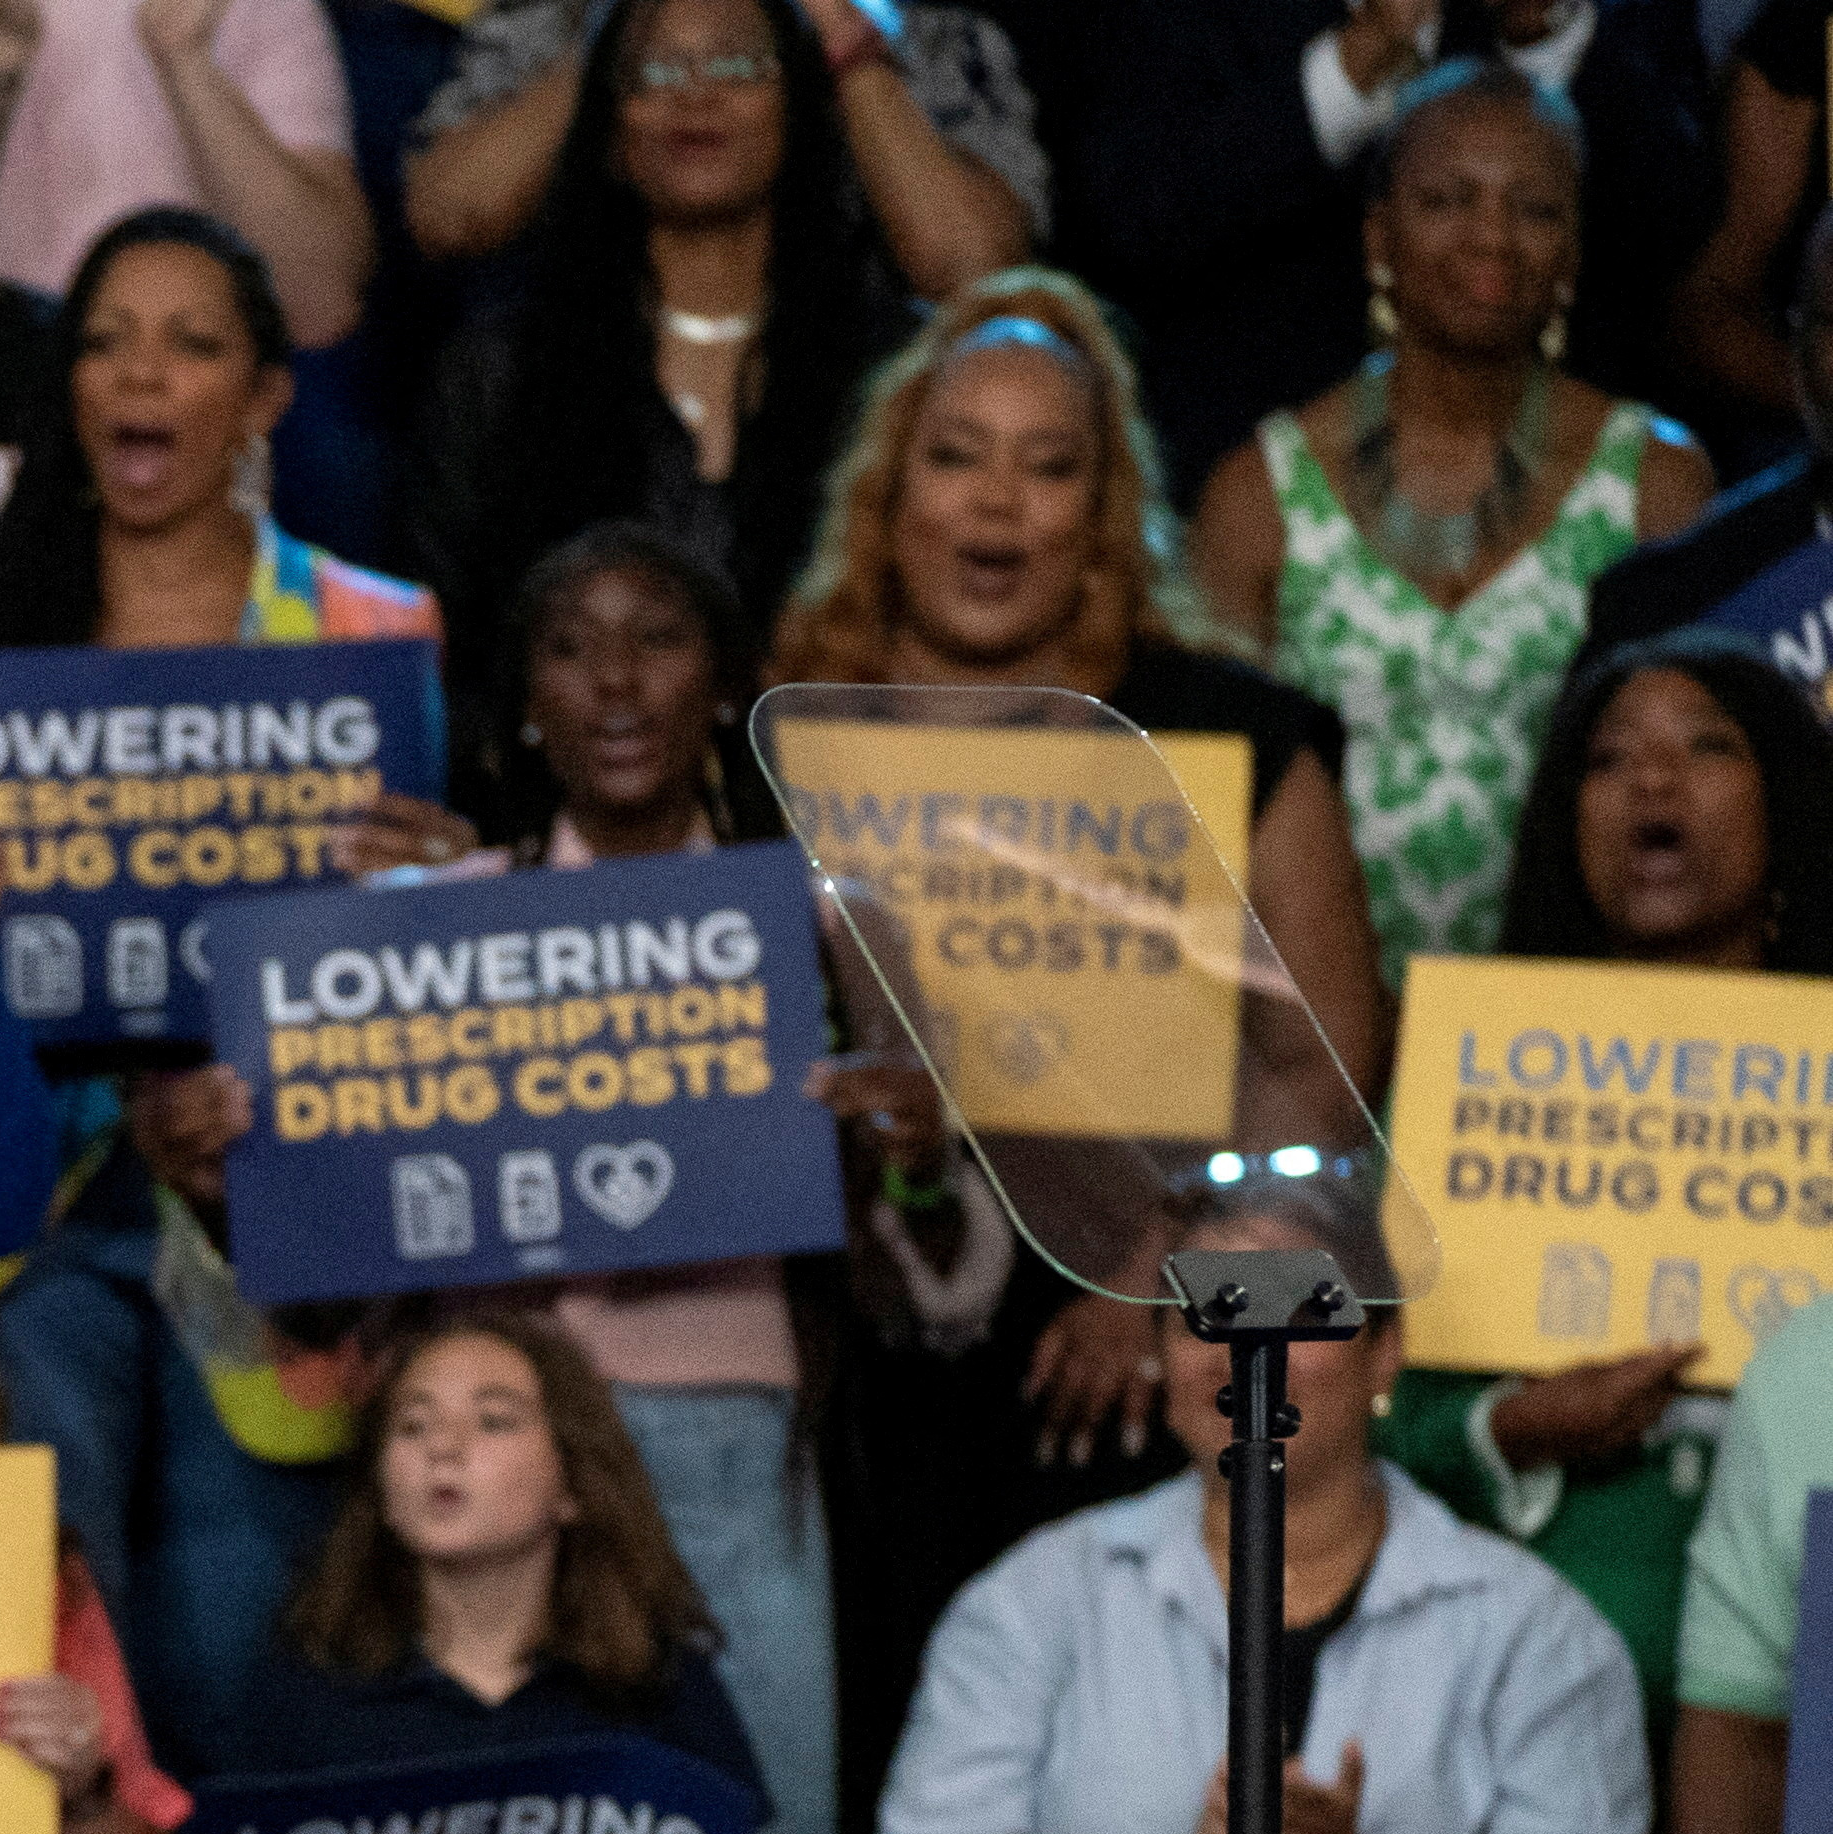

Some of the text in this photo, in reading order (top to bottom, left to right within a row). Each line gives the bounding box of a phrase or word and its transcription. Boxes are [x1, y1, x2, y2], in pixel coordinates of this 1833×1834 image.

[130, 823, 329, 888] COST
[261, 908, 763, 1026] LOWERING
[269, 982, 770, 1077] PRESCRIPTION
[1457, 1026, 1833, 1108] LOWERI
[274, 1036, 773, 1142] DRUG COSTS
[1445, 1149, 1661, 1216] DRUG
